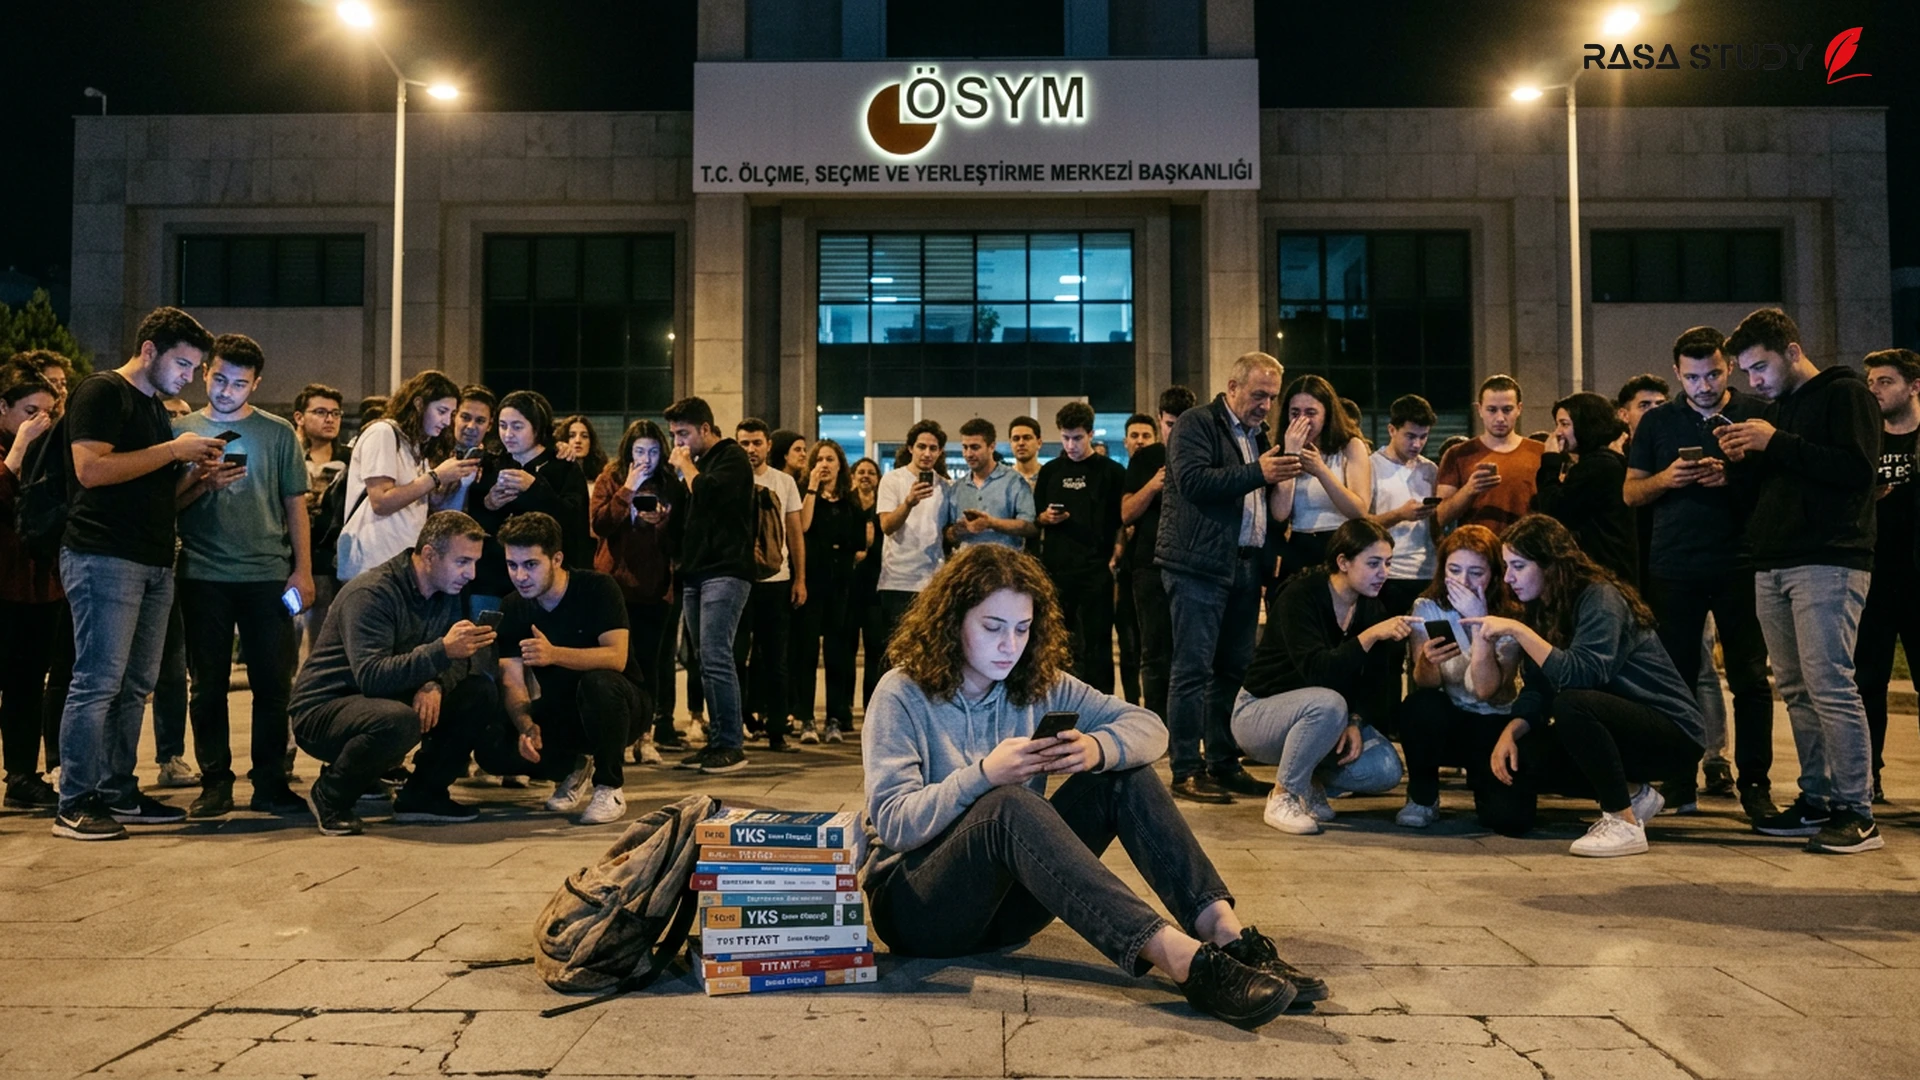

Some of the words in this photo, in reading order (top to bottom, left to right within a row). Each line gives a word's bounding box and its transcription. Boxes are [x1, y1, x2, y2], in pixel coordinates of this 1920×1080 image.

[906, 67, 1084, 119] ÖSYM
[701, 165, 733, 183] T.C.
[738, 162, 810, 187] ÖLÇME,
[815, 165, 880, 186] SEÇME
[885, 165, 910, 182] VE
[915, 161, 1045, 186] YERLEŞTİRME
[1051, 160, 1133, 181] MERKEZİ
[1138, 158, 1253, 185] BAŞKANLIĞI
[735, 828, 766, 844] YKS
[746, 909, 779, 925] YKS
